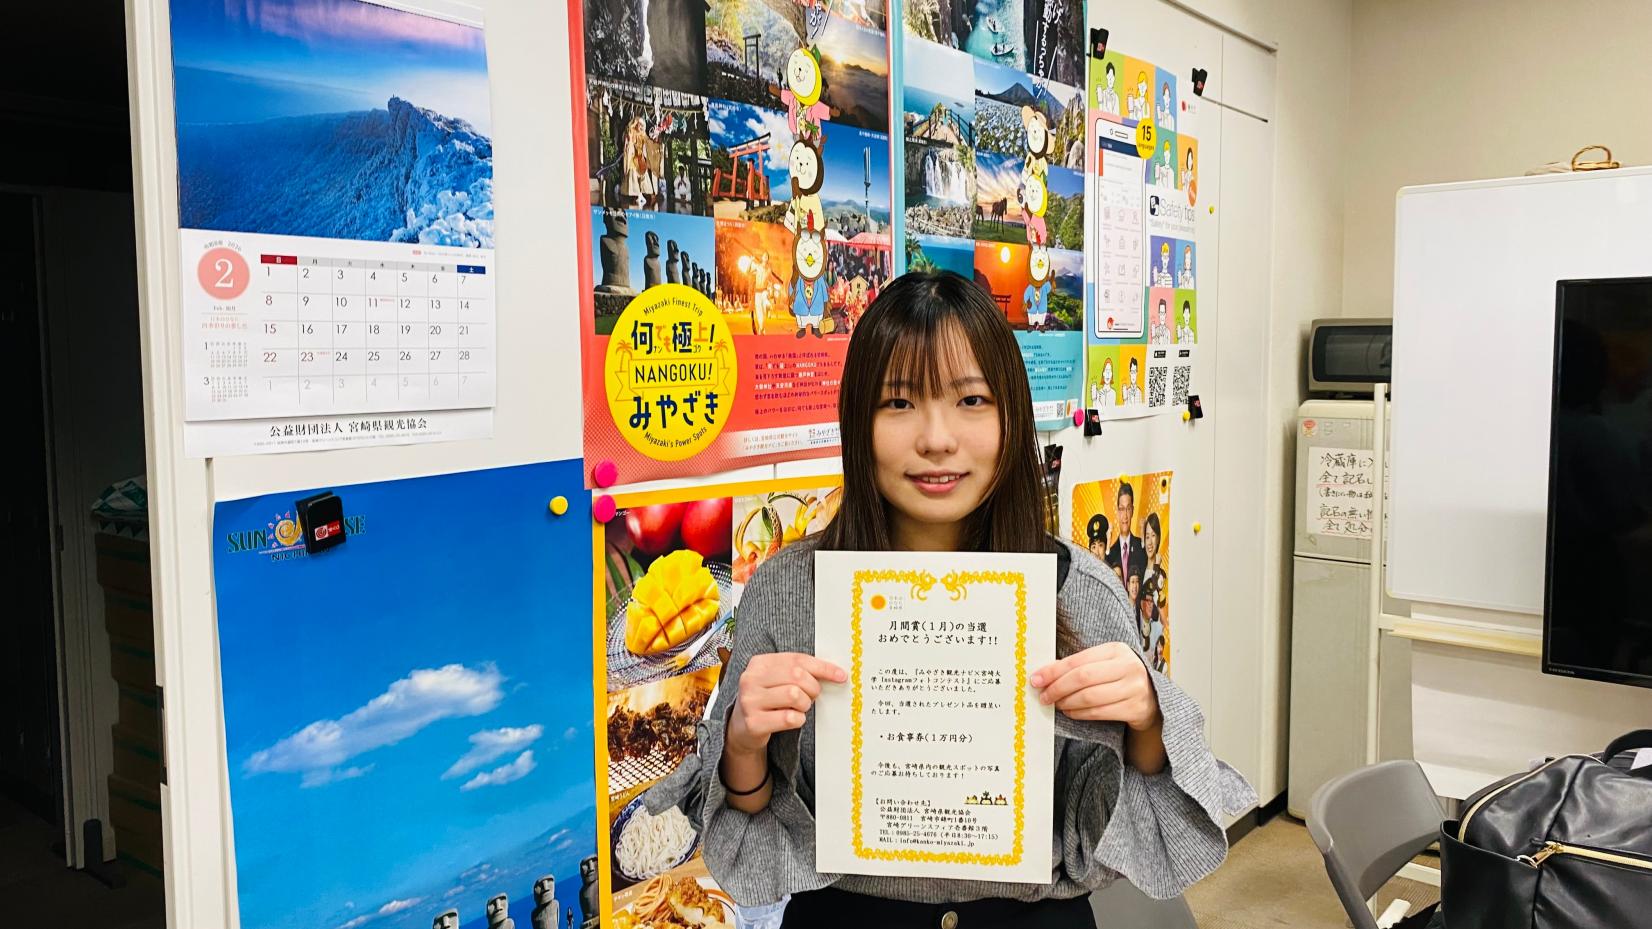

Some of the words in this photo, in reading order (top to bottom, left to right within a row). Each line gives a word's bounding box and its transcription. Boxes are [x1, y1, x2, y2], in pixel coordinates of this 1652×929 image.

[1142, 125, 1151, 141] 15
[1161, 198, 1183, 218] Safety
[1185, 207, 1194, 223] tips
[215, 258, 233, 288] 2
[267, 266, 270, 277] 1
[303, 268, 309, 278] 2
[338, 269, 344, 279] 3
[371, 272, 376, 280] 4
[402, 273, 407, 282] 5
[432, 274, 438, 283] 6
[461, 275, 466, 284] 7
[266, 295, 272, 305] 8
[303, 296, 309, 306] 9
[336, 297, 347, 307] 10
[369, 298, 377, 308] 11
[400, 299, 410, 308] 12
[431, 300, 441, 309] 13
[460, 301, 469, 309] 14
[643, 298, 670, 316] Miyazaki
[673, 298, 691, 308] Finest
[693, 303, 703, 316] Trip
[265, 324, 276, 333] 15
[302, 324, 313, 334] 16
[337, 324, 347, 334] 17
[369, 325, 379, 334] 18
[401, 325, 411, 334] 19
[430, 325, 441, 335] 20
[459, 325, 468, 335] 21
[264, 352, 277, 362] 22
[301, 352, 313, 361] 23
[336, 352, 347, 361] 24
[368, 351, 380, 361] 25
[400, 351, 411, 360] 26
[430, 351, 441, 360] 27
[459, 351, 470, 360] 28
[204, 377, 209, 385] 3
[635, 363, 712, 383] NANGOKU!
[629, 391, 718, 430] みやざき
[270, 422, 343, 437] 公益財団法人
[349, 417, 427, 433] 宮崎県観光協会
[644, 432, 673, 448] Miyazaki's
[676, 438, 692, 447] Power
[693, 427, 707, 440] Spots
[227, 529, 267, 552] SUN
[924, 808, 971, 816] 宮崎県観光協会
